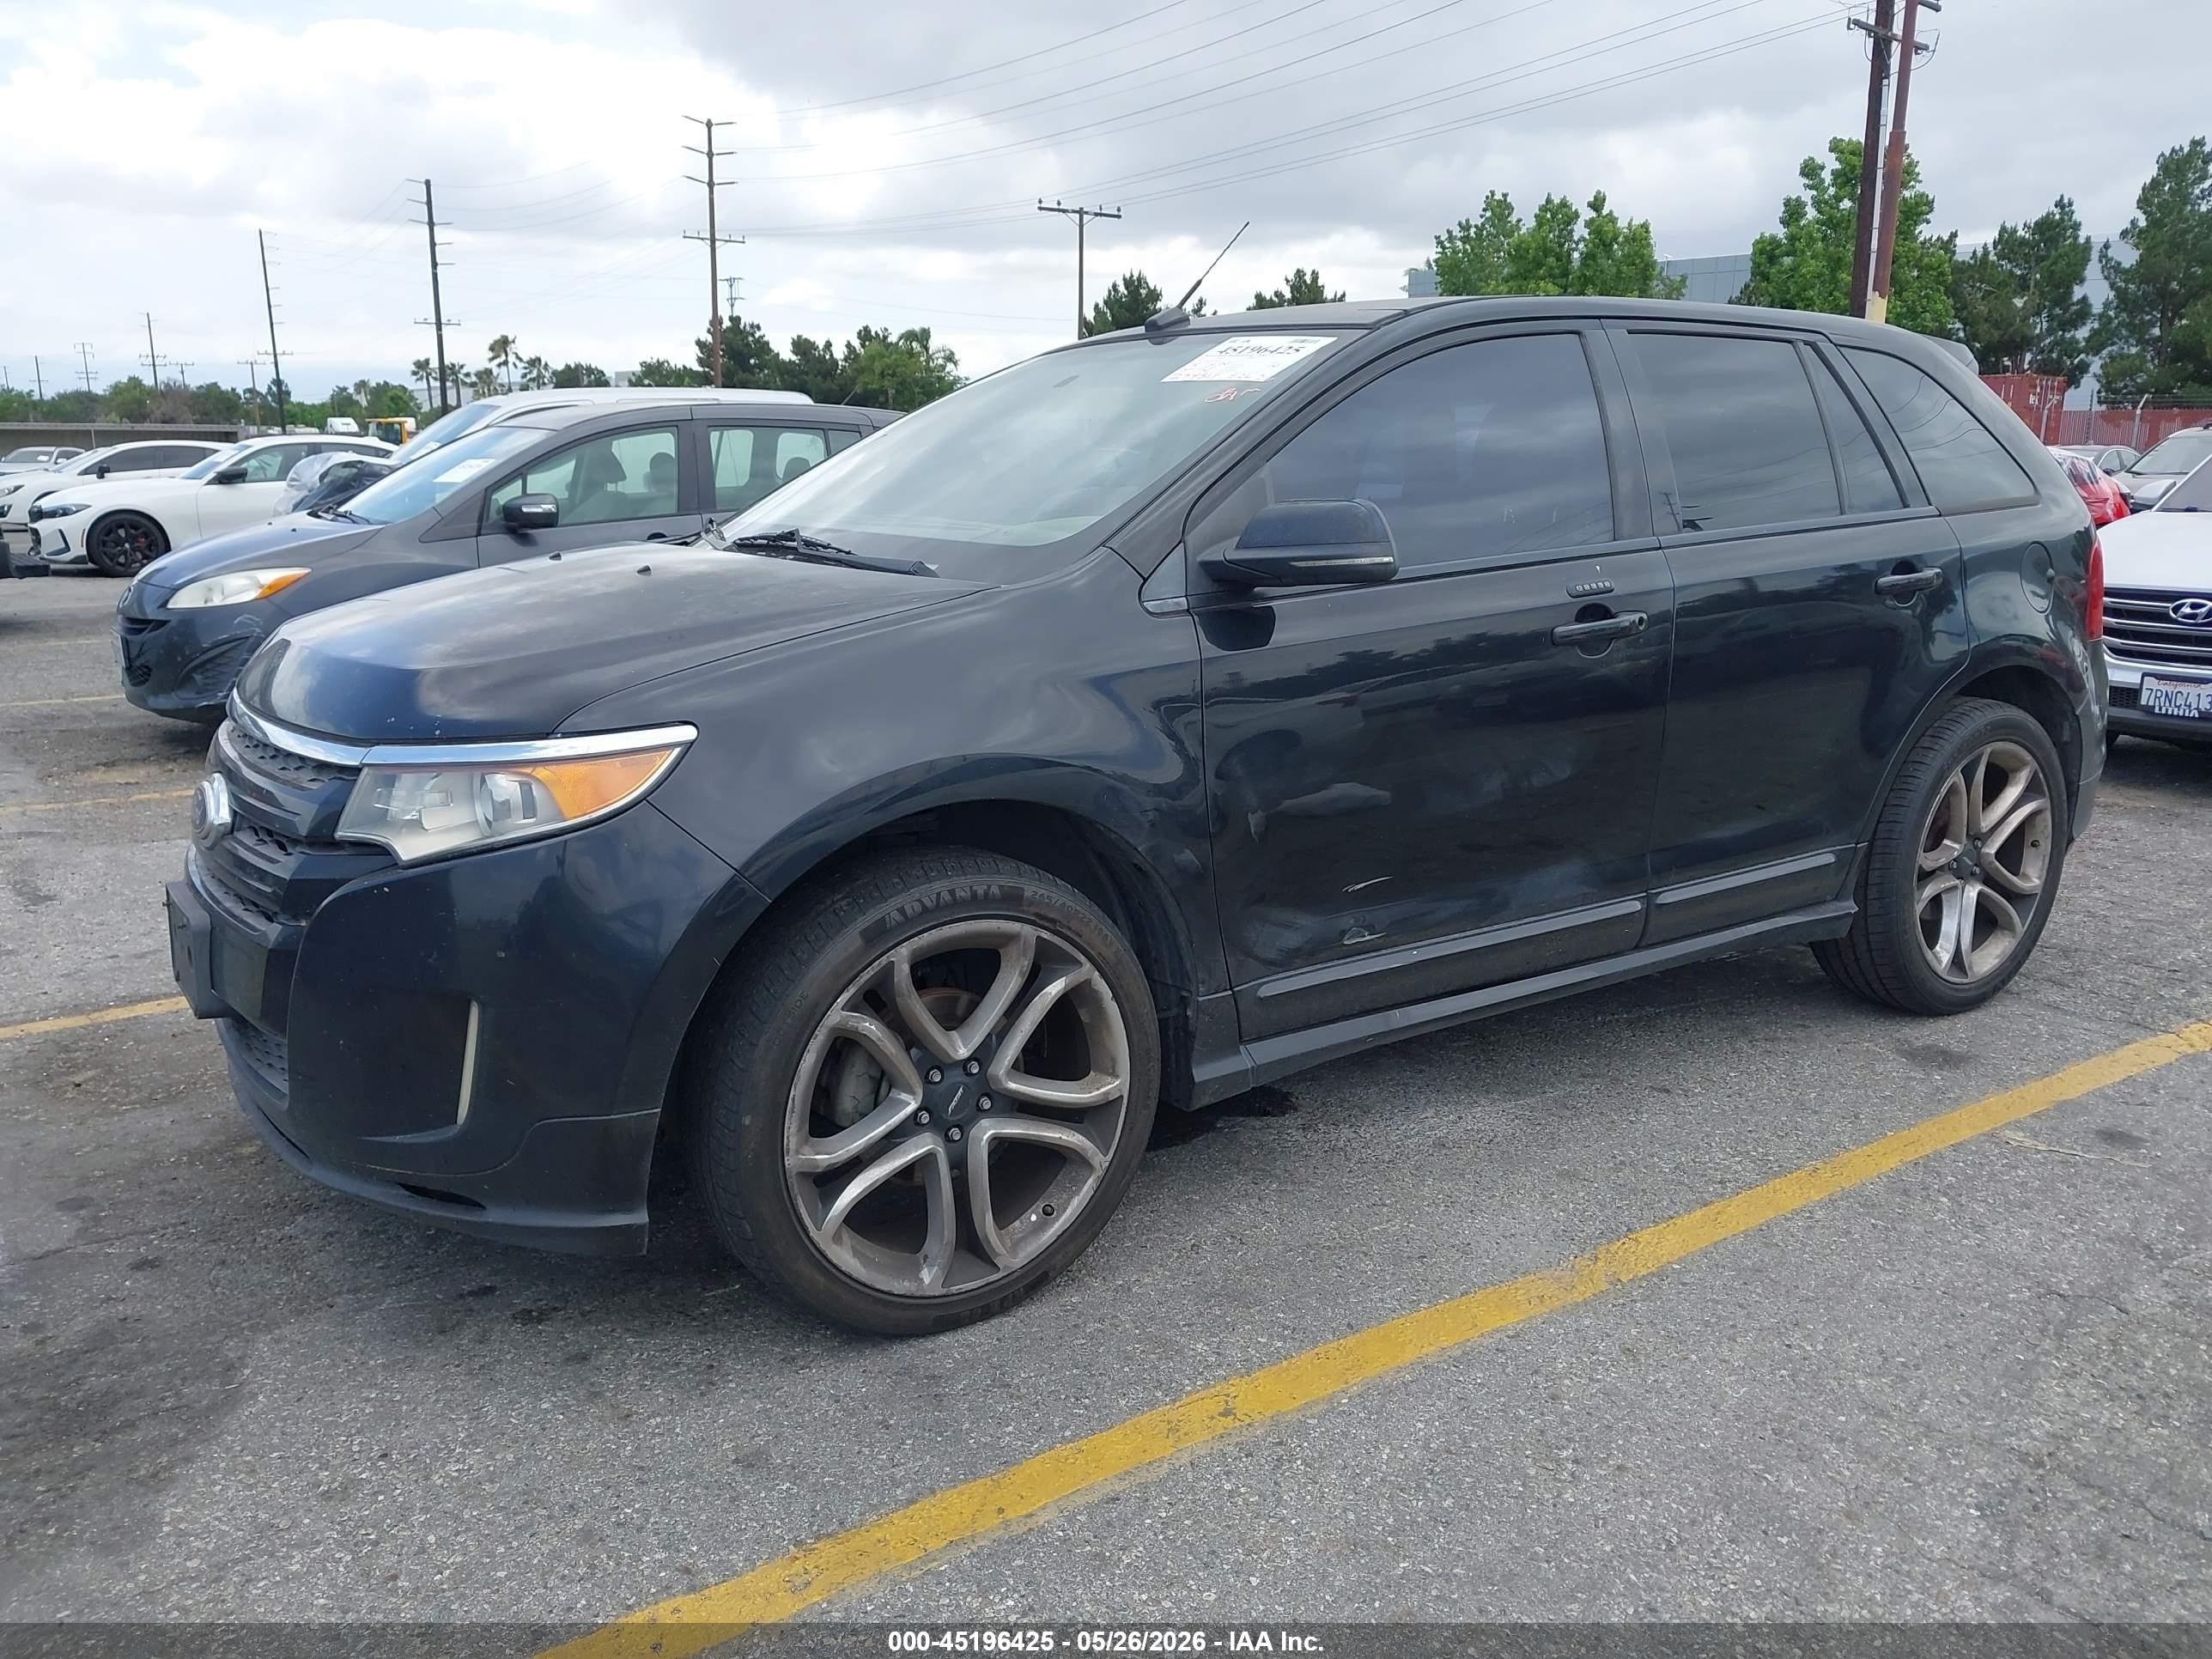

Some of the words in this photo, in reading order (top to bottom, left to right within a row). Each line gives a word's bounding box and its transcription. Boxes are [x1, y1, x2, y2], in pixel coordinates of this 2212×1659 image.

[2145, 688, 2212, 711] 7RNC413
[2154, 704, 2199, 718] LITHIA
[884, 884, 1002, 929] ADVANTA
